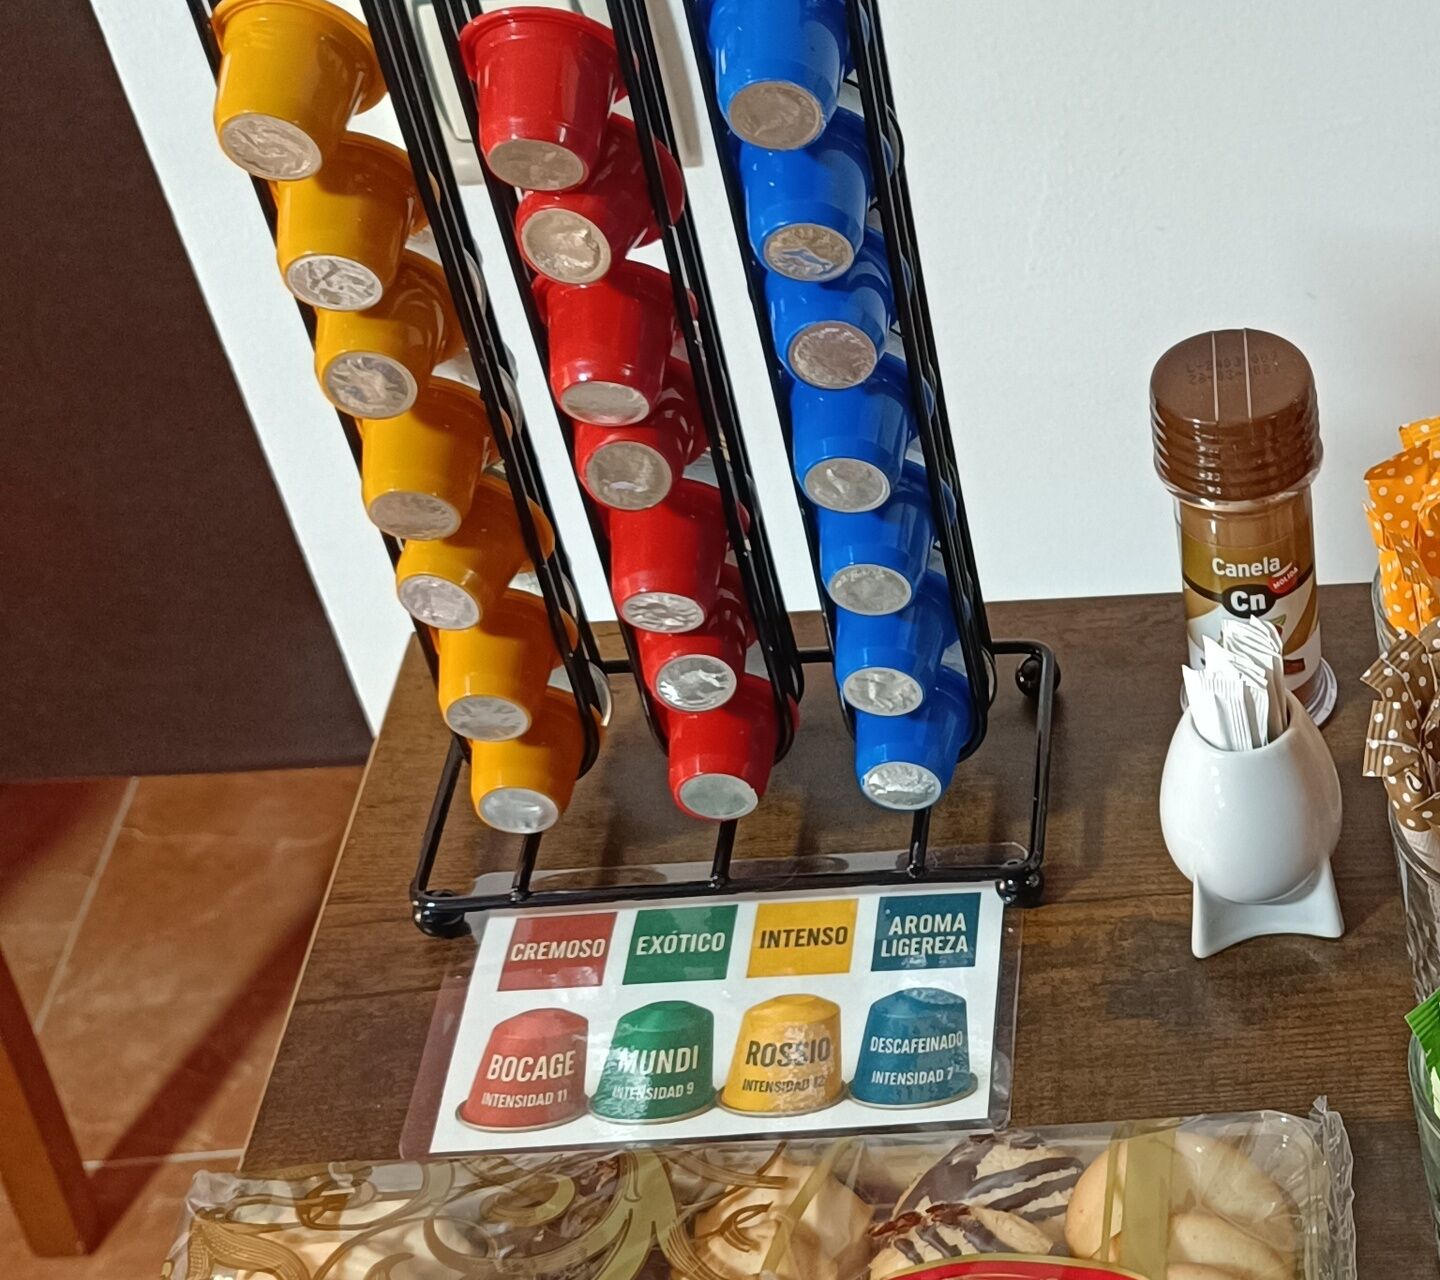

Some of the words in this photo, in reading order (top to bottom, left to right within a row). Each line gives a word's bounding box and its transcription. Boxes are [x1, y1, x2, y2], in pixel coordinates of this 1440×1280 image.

[1212, 557, 1281, 577] Canela
[1230, 590, 1266, 612] Cn
[888, 912, 967, 936] AROMA
[636, 930, 726, 956] EXÓTICO
[759, 926, 848, 950] INTENSO
[880, 935, 969, 958] LIGEREZA
[510, 938, 606, 962] CREMOSO
[746, 1039, 831, 1068] ROSSIO
[870, 1032, 964, 1054] DESCAFEINADO
[486, 1050, 576, 1082] BOCAGE
[617, 1044, 699, 1076] MUNDI
[742, 1077, 808, 1094] INTENSIDAD
[812, 1075, 826, 1089] 12
[871, 1068, 942, 1085] INTENSIDAD
[946, 1067, 954, 1080] 7
[482, 1092, 552, 1108] INTENSIDAD
[555, 1089, 568, 1104] 11
[612, 1084, 682, 1100] INTENSIDAD
[686, 1082, 694, 1096] 9
